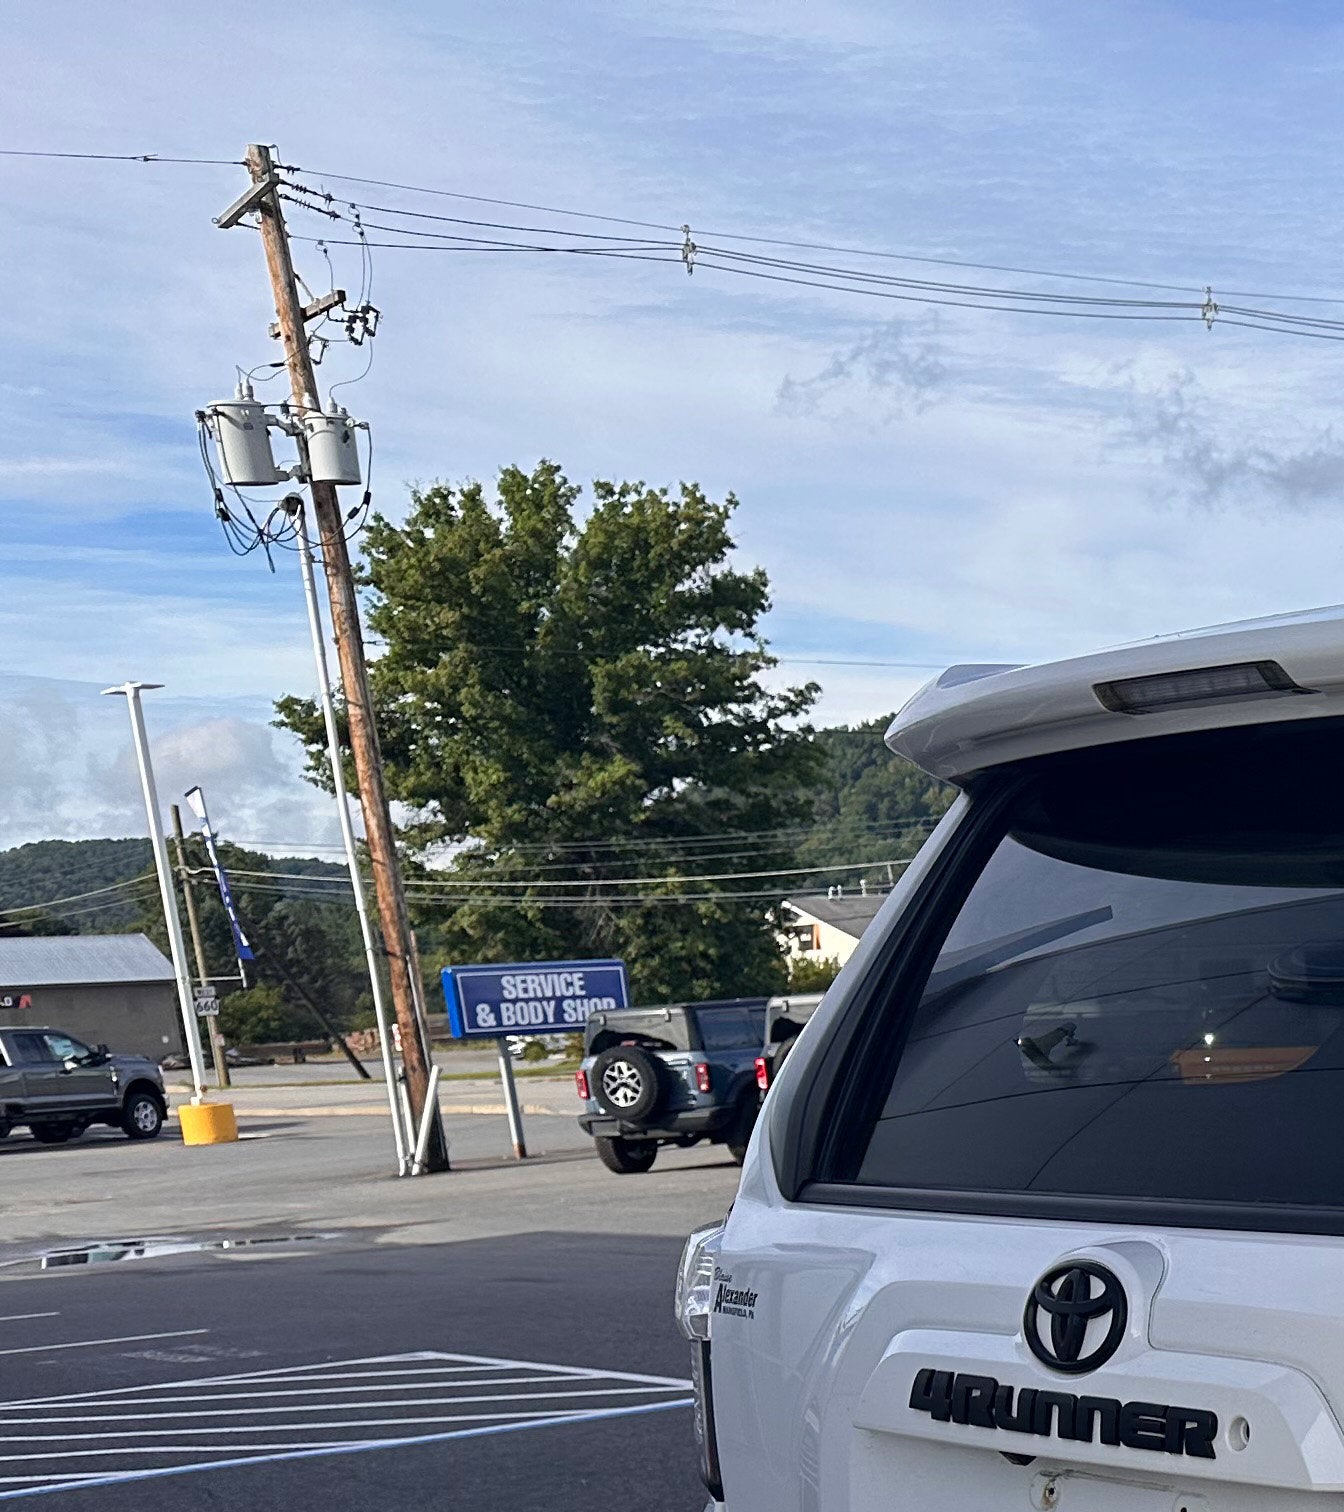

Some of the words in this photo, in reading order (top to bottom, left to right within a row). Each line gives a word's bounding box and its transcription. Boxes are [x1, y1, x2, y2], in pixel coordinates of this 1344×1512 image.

[501, 973, 586, 999] SERVICE
[196, 1000, 218, 1012] 660
[476, 1003, 497, 1027] &
[500, 1001, 556, 1026] BODY
[713, 1283, 758, 1313] Alexander
